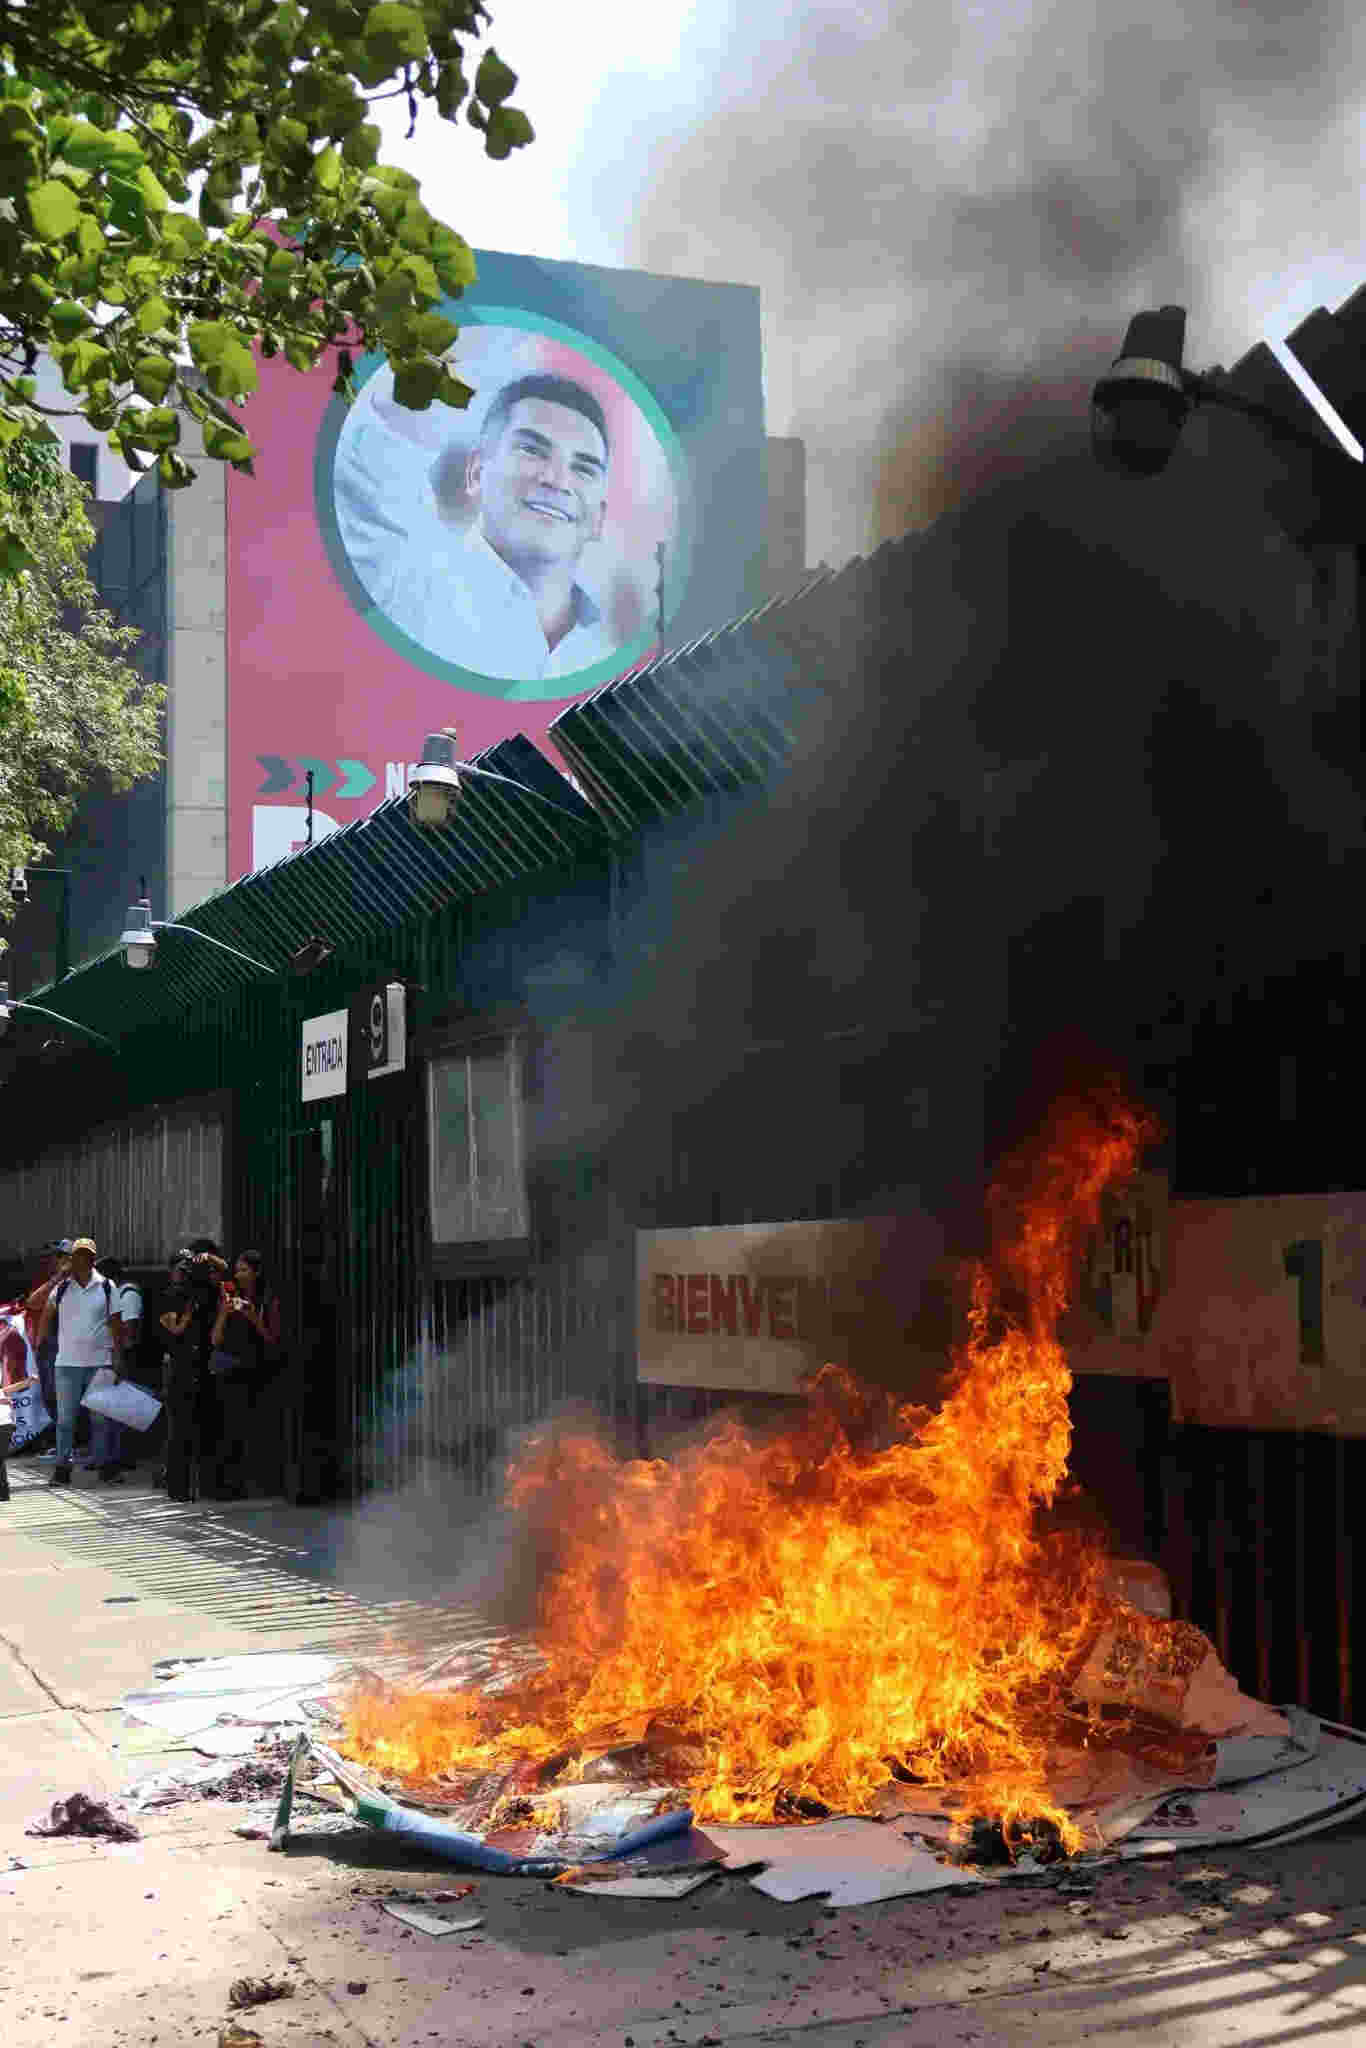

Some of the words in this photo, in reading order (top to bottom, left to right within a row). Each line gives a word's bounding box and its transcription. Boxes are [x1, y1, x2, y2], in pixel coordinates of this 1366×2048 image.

[306, 1034, 343, 1076] ENTRADA
[654, 1272, 800, 1339] BIENVE
[1284, 1240, 1325, 1365] 1
